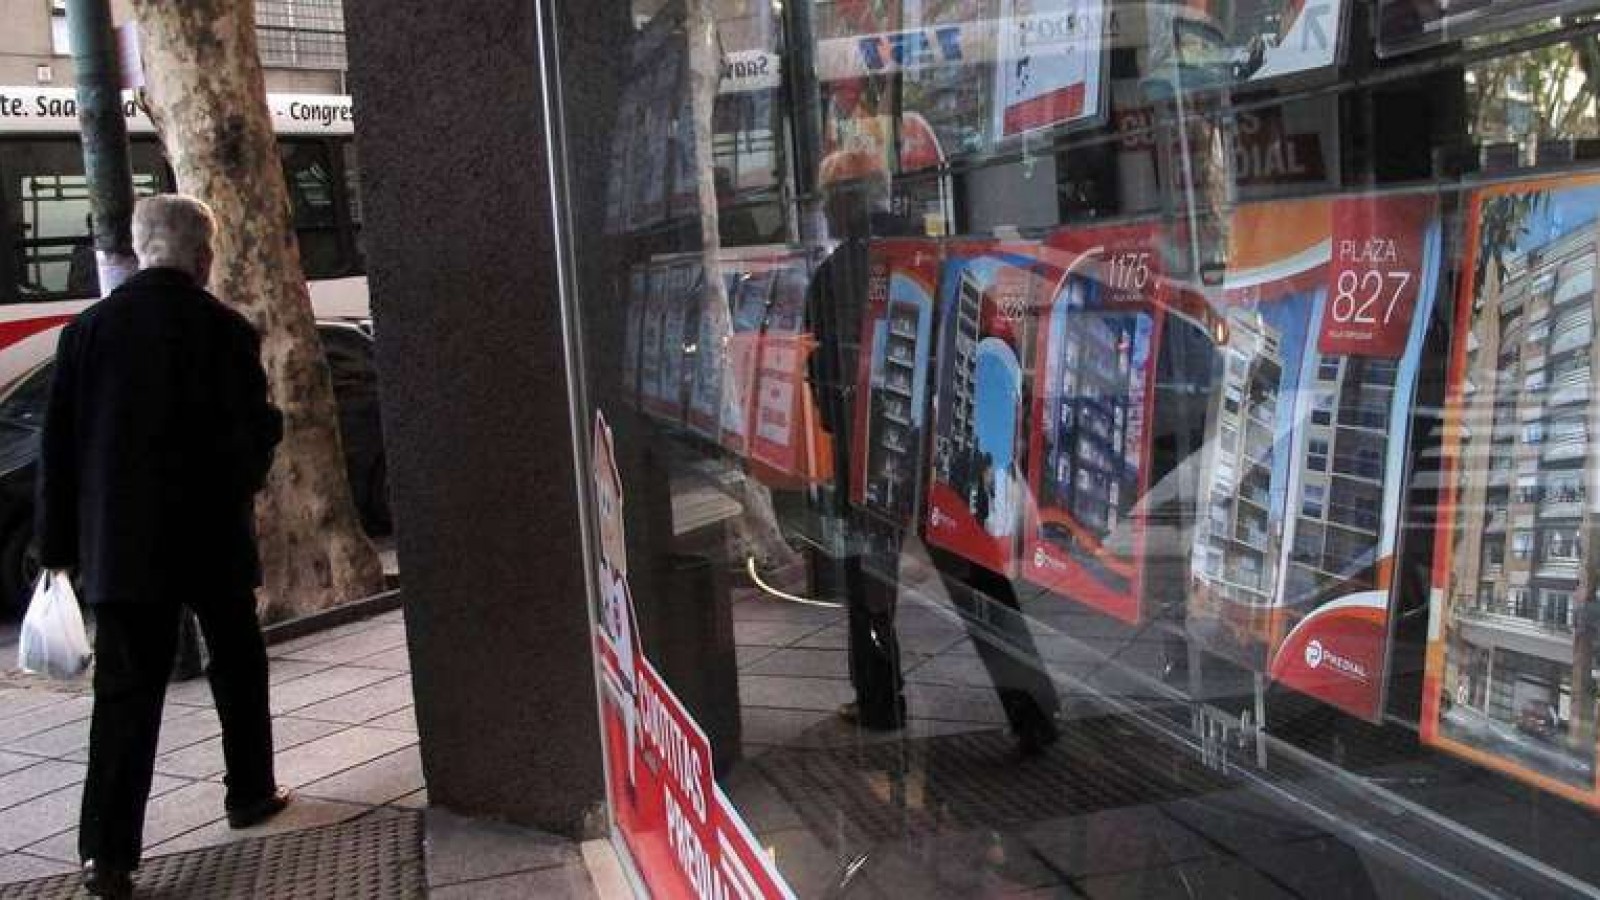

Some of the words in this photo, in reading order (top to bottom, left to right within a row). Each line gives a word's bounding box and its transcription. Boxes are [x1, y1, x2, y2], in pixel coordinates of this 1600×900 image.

[1340, 240, 1398, 262] PLAZA
[1109, 252, 1150, 289] 1175
[1333, 270, 1411, 325] 827
